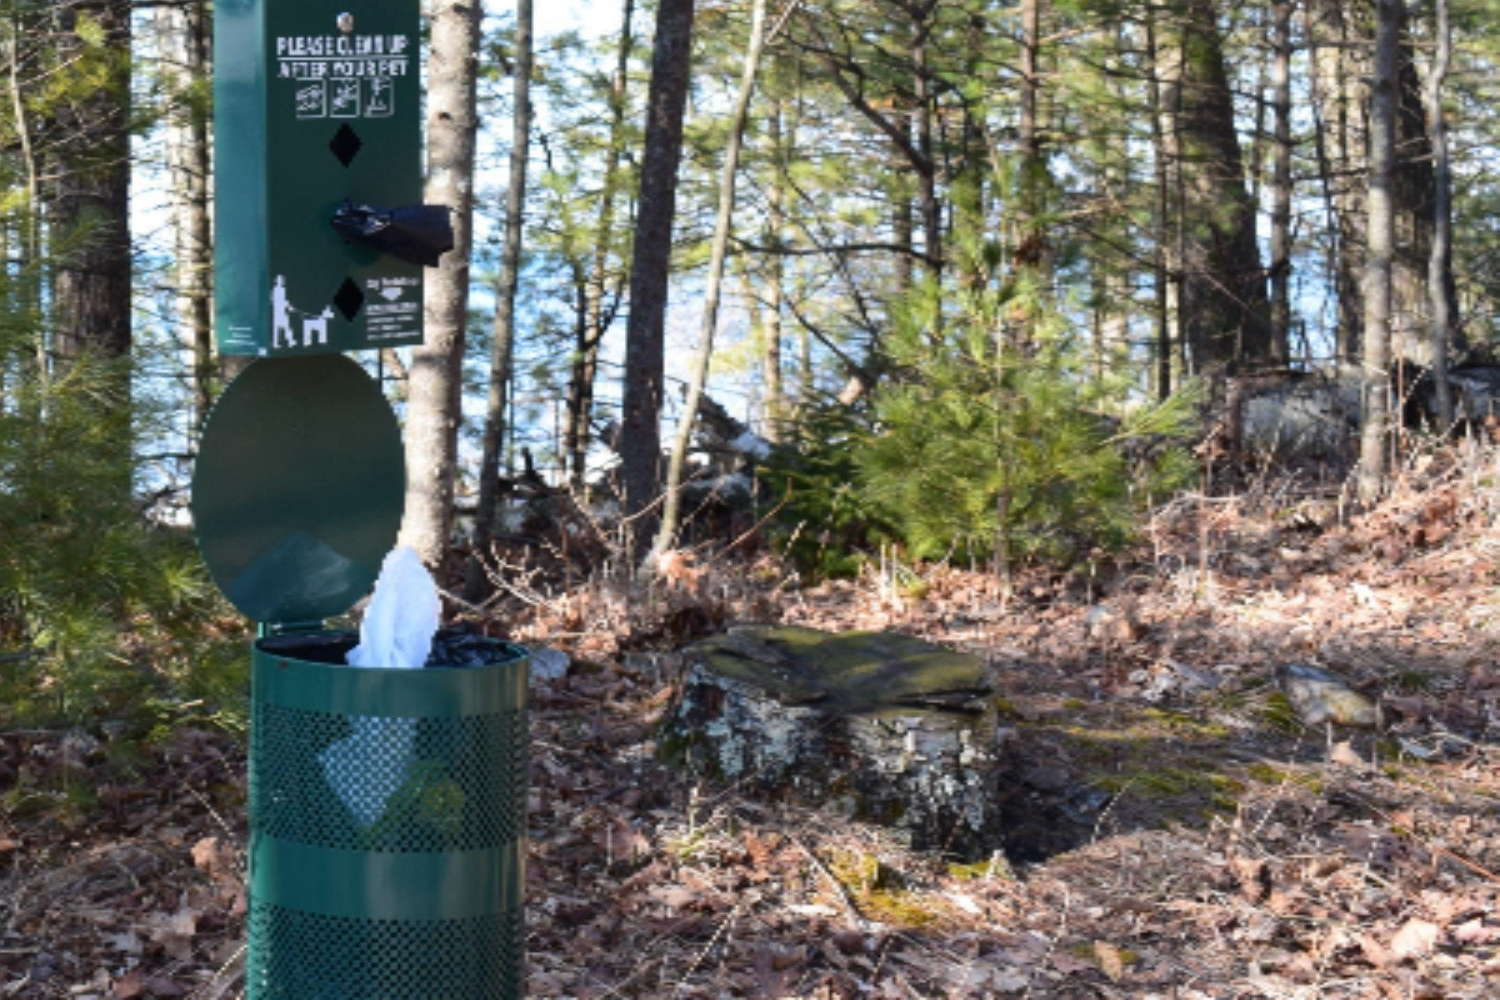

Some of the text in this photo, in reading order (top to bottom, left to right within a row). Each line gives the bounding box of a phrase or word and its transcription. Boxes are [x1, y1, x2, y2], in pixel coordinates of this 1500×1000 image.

[276, 36, 335, 56] PLEASE
[276, 60, 408, 78] AFTER YOUR PET
